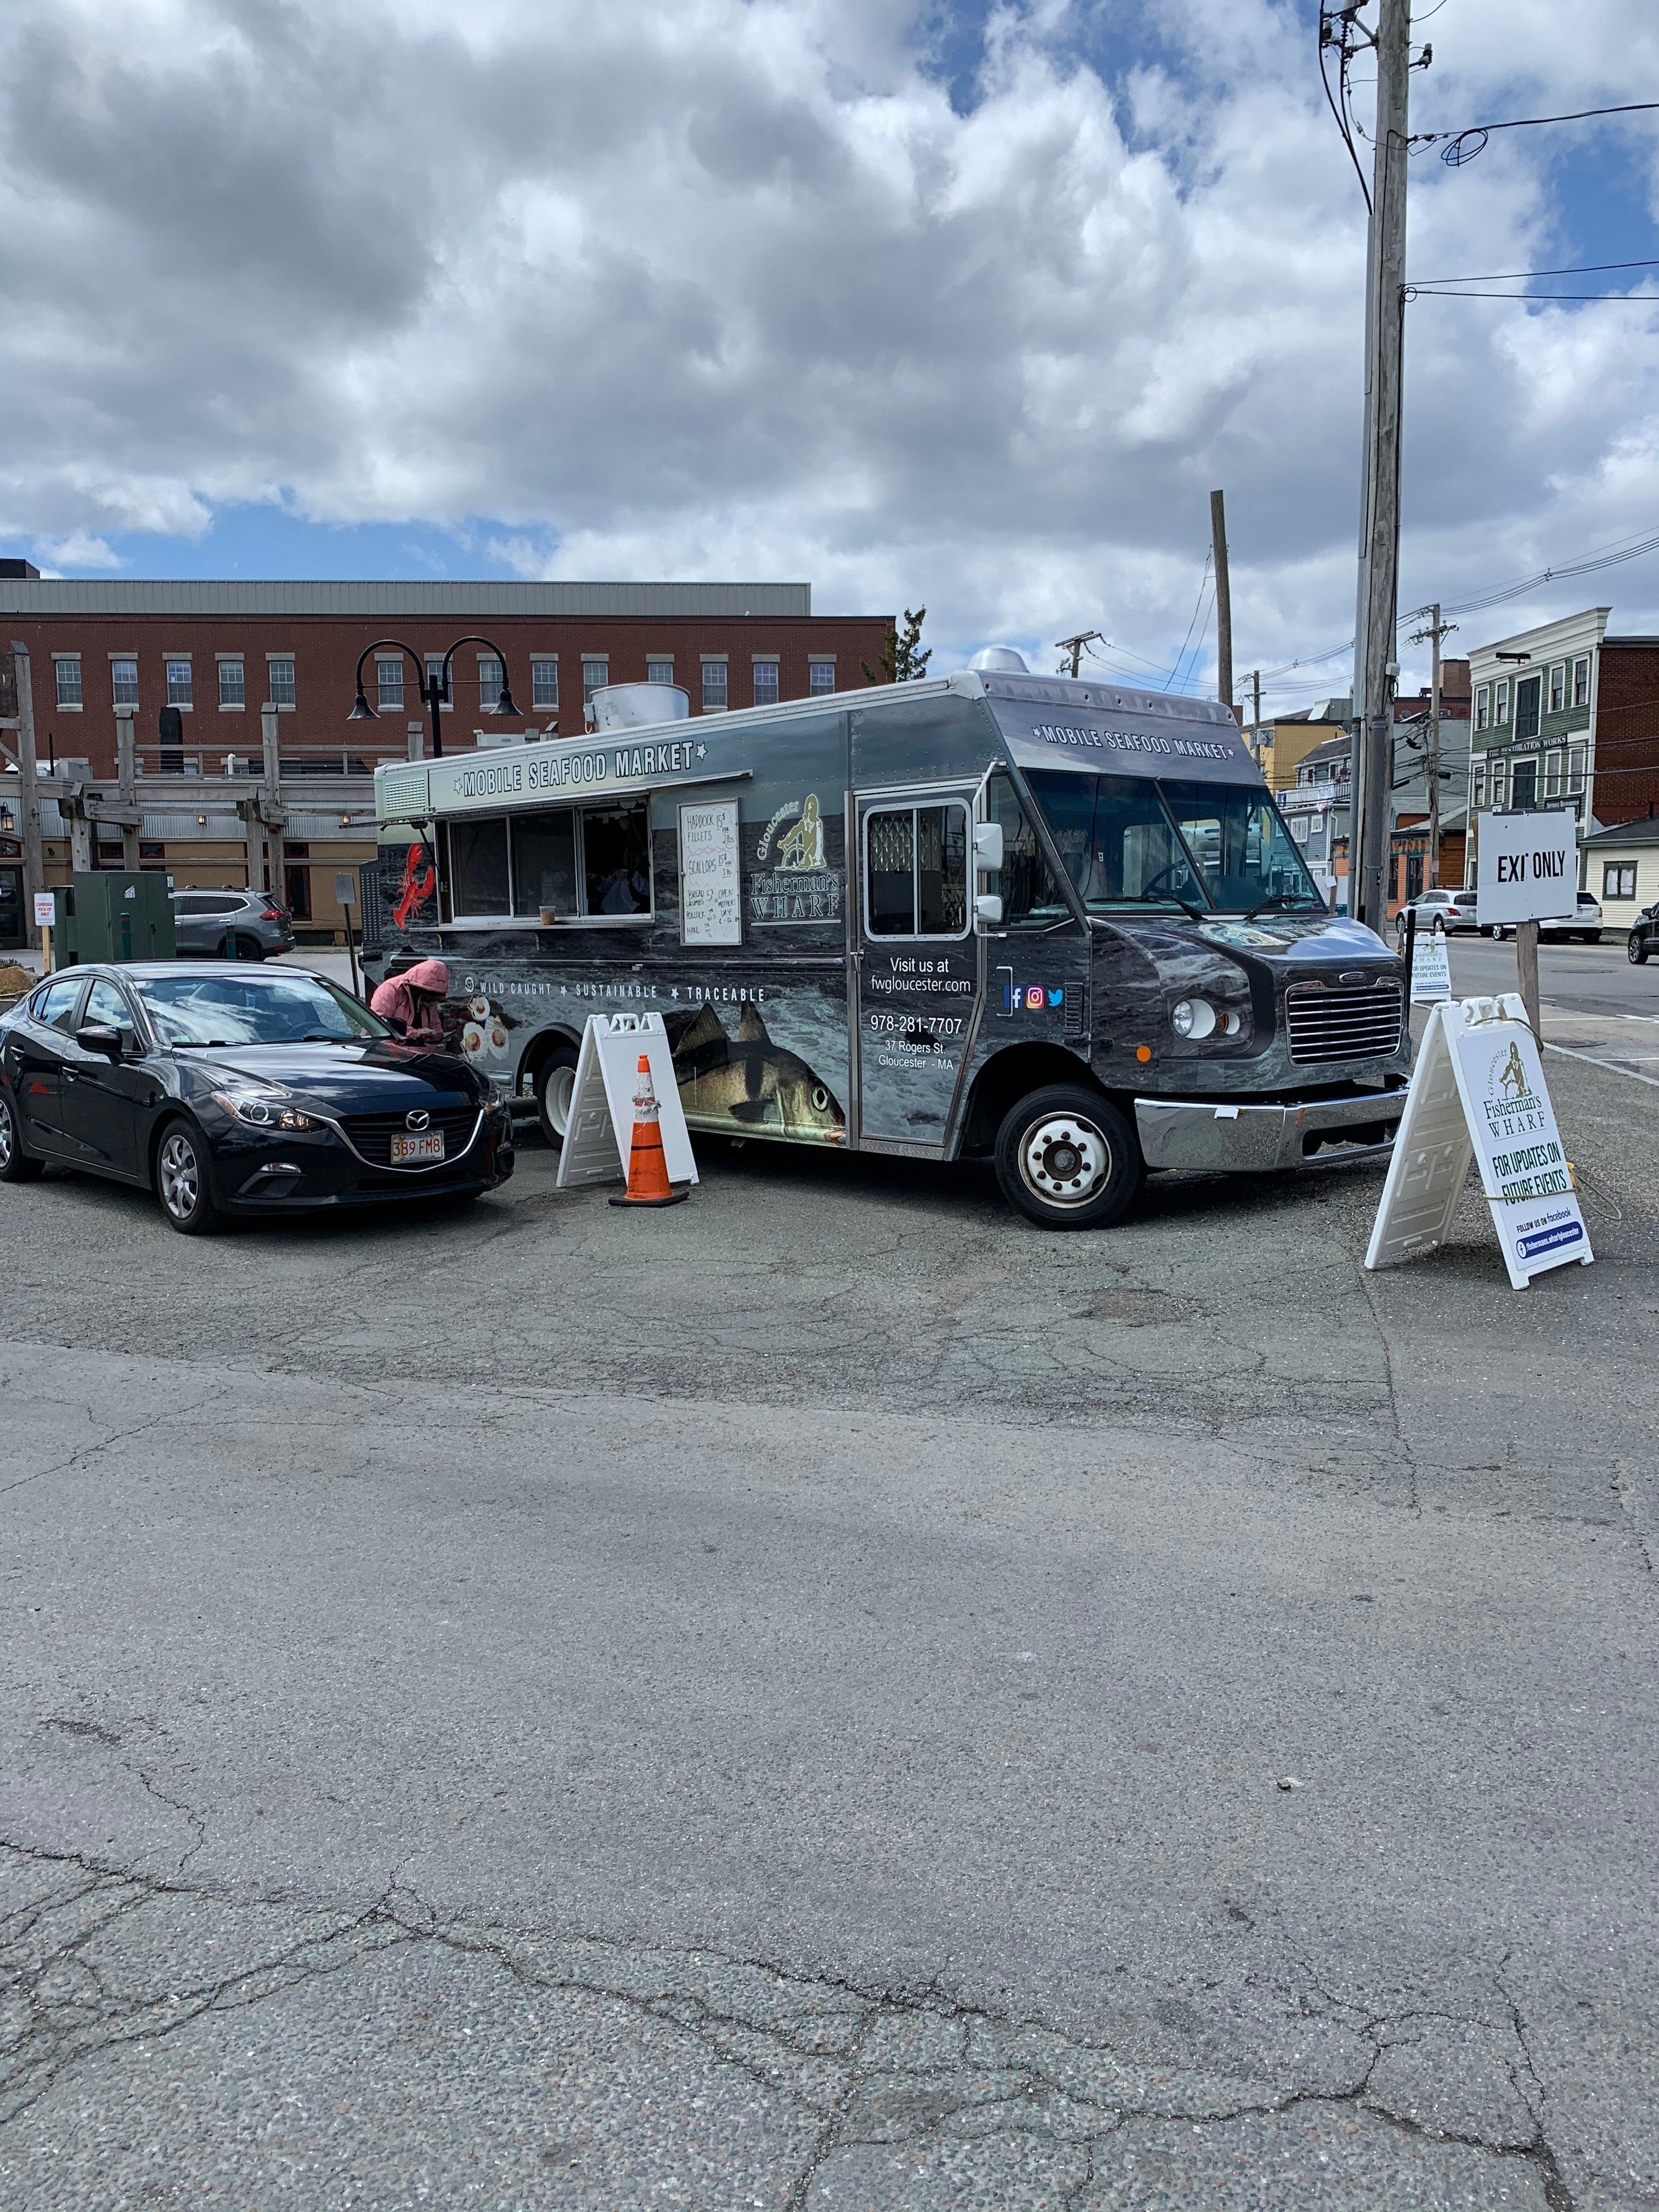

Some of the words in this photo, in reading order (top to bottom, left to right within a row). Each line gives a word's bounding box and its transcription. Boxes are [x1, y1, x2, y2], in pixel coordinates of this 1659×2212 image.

[1041, 725, 1103, 747] MOBILE
[1104, 731, 1171, 754] SEAFOOD
[1173, 738, 1228, 760] MARKET
[1501, 741, 1542, 755] RESTORATION
[1543, 735, 1566, 747] WORKS
[463, 765, 522, 797] MOBILE
[528, 753, 607, 789] SEAFOOD
[615, 741, 694, 778] MARKET
[687, 814, 715, 830] HADDOCK
[757, 800, 799, 861] Gloucester
[688, 830, 712, 842] FILLETS
[689, 859, 716, 876] SCALLOPS
[1498, 853, 1529, 883] EXI
[1533, 850, 1565, 879] ONLY
[718, 888, 733, 899] OPEN
[751, 872, 839, 895] Fisherman's
[689, 889, 704, 900] BREAD
[686, 911, 706, 920] POLLOCK
[751, 894, 839, 919] WHARF
[687, 927, 700, 936] HAKE
[890, 957, 916, 972] Visit
[919, 961, 933, 973] us
[937, 958, 949, 973] at
[480, 982, 504, 994] WILD
[511, 983, 551, 995] CAUGHT
[576, 984, 657, 998] SUSTAINABLE
[687, 987, 764, 1002] TRACEABLE
[871, 975, 970, 994] fwgloucester.com
[871, 1014, 962, 1035] 978-281-7707
[885, 1040, 896, 1051] 37
[899, 1040, 930, 1055] Rogers
[933, 1042, 946, 1054] St.
[878, 1054, 927, 1068] Gloucester
[938, 1058, 953, 1070] MA
[1487, 1049, 1507, 1096] Gloucester
[1483, 1096, 1542, 1119] Fisherman's
[1488, 1111, 1544, 1138] WHARF
[393, 1141, 416, 1156] 389
[419, 1138, 440, 1155] FM8
[1492, 1154, 1513, 1178] FOR
[1509, 1144, 1548, 1173] UPDATES
[1547, 1141, 1561, 1164] ON
[1502, 1177, 1536, 1206] FUTURE
[1534, 1169, 1567, 1194] EVENTS
[1516, 1221, 1534, 1234] FOLLOW
[1534, 1219, 1541, 1228] US
[1541, 1217, 1548, 1226] ON
[1547, 1207, 1572, 1223] facebook
